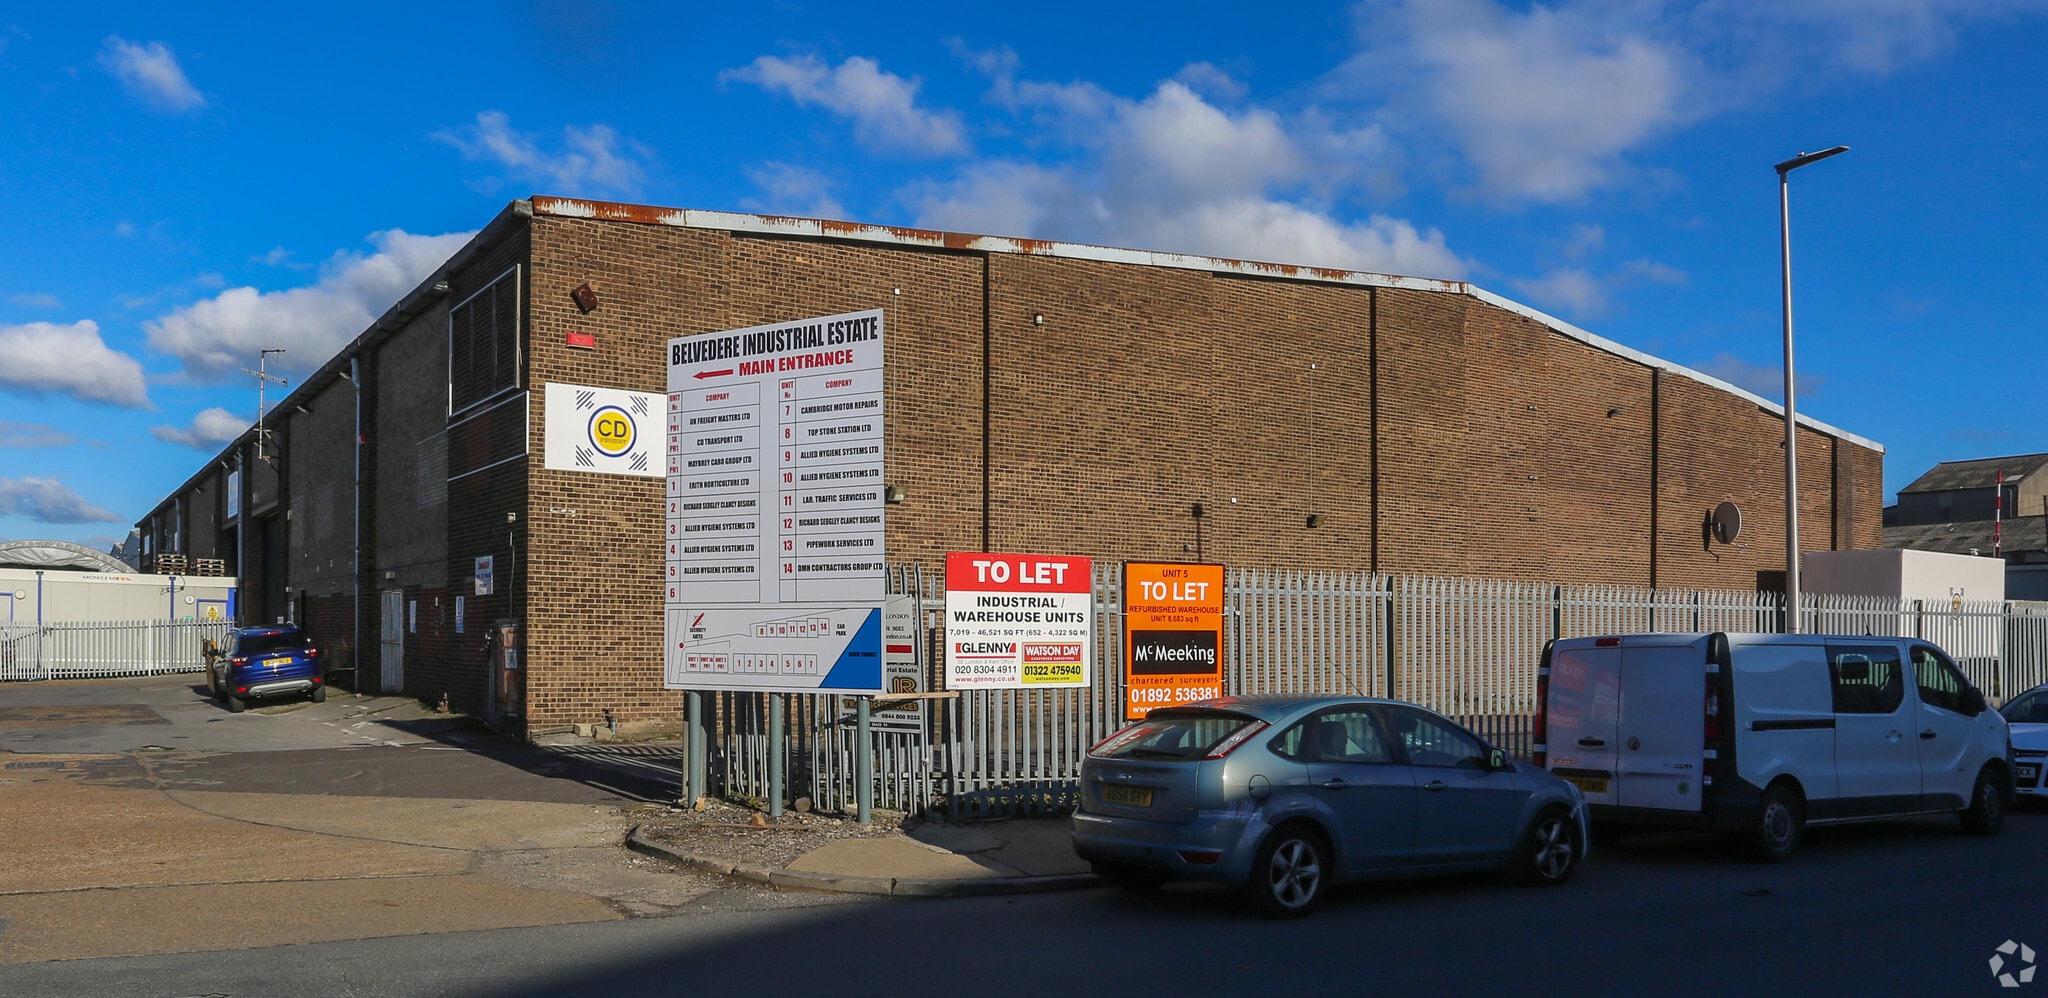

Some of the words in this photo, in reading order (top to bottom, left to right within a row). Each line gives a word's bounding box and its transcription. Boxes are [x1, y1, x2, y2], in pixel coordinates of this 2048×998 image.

[672, 336, 739, 365] BELVEDERE
[743, 325, 824, 356] INDUSTRIAL
[828, 317, 878, 345] ESTATE
[739, 359, 774, 376] MAIN
[779, 350, 853, 371] ENTRANCE
[826, 379, 852, 388] COMPANY
[706, 393, 729, 401] COMPANY
[785, 406, 790, 416] 7
[801, 404, 832, 414] CAMBRIDGE
[834, 403, 853, 411] MOTOR
[855, 400, 878, 409] REPAIRS
[698, 416, 717, 424] FREIGHT
[718, 414, 741, 422] MASTERS
[598, 420, 626, 437] CD
[785, 428, 790, 439] 8
[819, 427, 836, 436] STONE
[838, 425, 860, 434] STATION
[705, 437, 733, 445] TRANSPORT
[785, 451, 790, 461] 9
[801, 451, 818, 459] ALLIED
[819, 449, 841, 457] HYGIENE
[842, 447, 868, 456] SYSTEMS
[869, 446, 878, 454] LTD
[783, 473, 792, 483] 10
[801, 473, 818, 481] ALLIED
[819, 472, 841, 480] HYGIENE
[842, 470, 868, 478] SYSTEMS
[672, 481, 675, 490] 1
[704, 479, 739, 488] HORTICULTURE
[784, 496, 792, 506] 11
[815, 495, 837, 503] TRAFFIC
[839, 493, 866, 501] SERVICES
[671, 503, 675, 513] 2
[721, 501, 737, 509] CLANCY
[783, 518, 792, 529] 12
[860, 516, 880, 524] DESIGNS
[670, 525, 675, 534] 3
[701, 523, 721, 531] HYGIENE
[783, 540, 792, 551] 13
[836, 539, 863, 547] SERVICES
[670, 545, 675, 554] 4
[701, 545, 721, 553] HYGIENE
[670, 566, 675, 576] 5
[783, 563, 793, 573] 14
[812, 563, 851, 571] CONTRACTORS
[973, 561, 1010, 583] TO
[1020, 562, 1068, 584] LET
[670, 588, 675, 598] 6
[1140, 581, 1167, 600] TO
[1173, 582, 1208, 601] LET
[977, 597, 1057, 608] INDUSTRIAL
[954, 611, 1040, 622] WAREHOUSE
[1046, 613, 1084, 622] UNITS
[962, 643, 1010, 653] GLENNY
[1026, 646, 1060, 655] WATSON
[1064, 646, 1079, 655] DAY
[1155, 645, 1215, 665] Meeking
[955, 666, 971, 674] 020
[997, 665, 1016, 673] 4911
[1025, 666, 1048, 675] 01322
[1051, 666, 1080, 675] 475940
[1131, 677, 1174, 685] chartered
[1131, 688, 1171, 703] 01892
[1176, 687, 1219, 701] 536381
